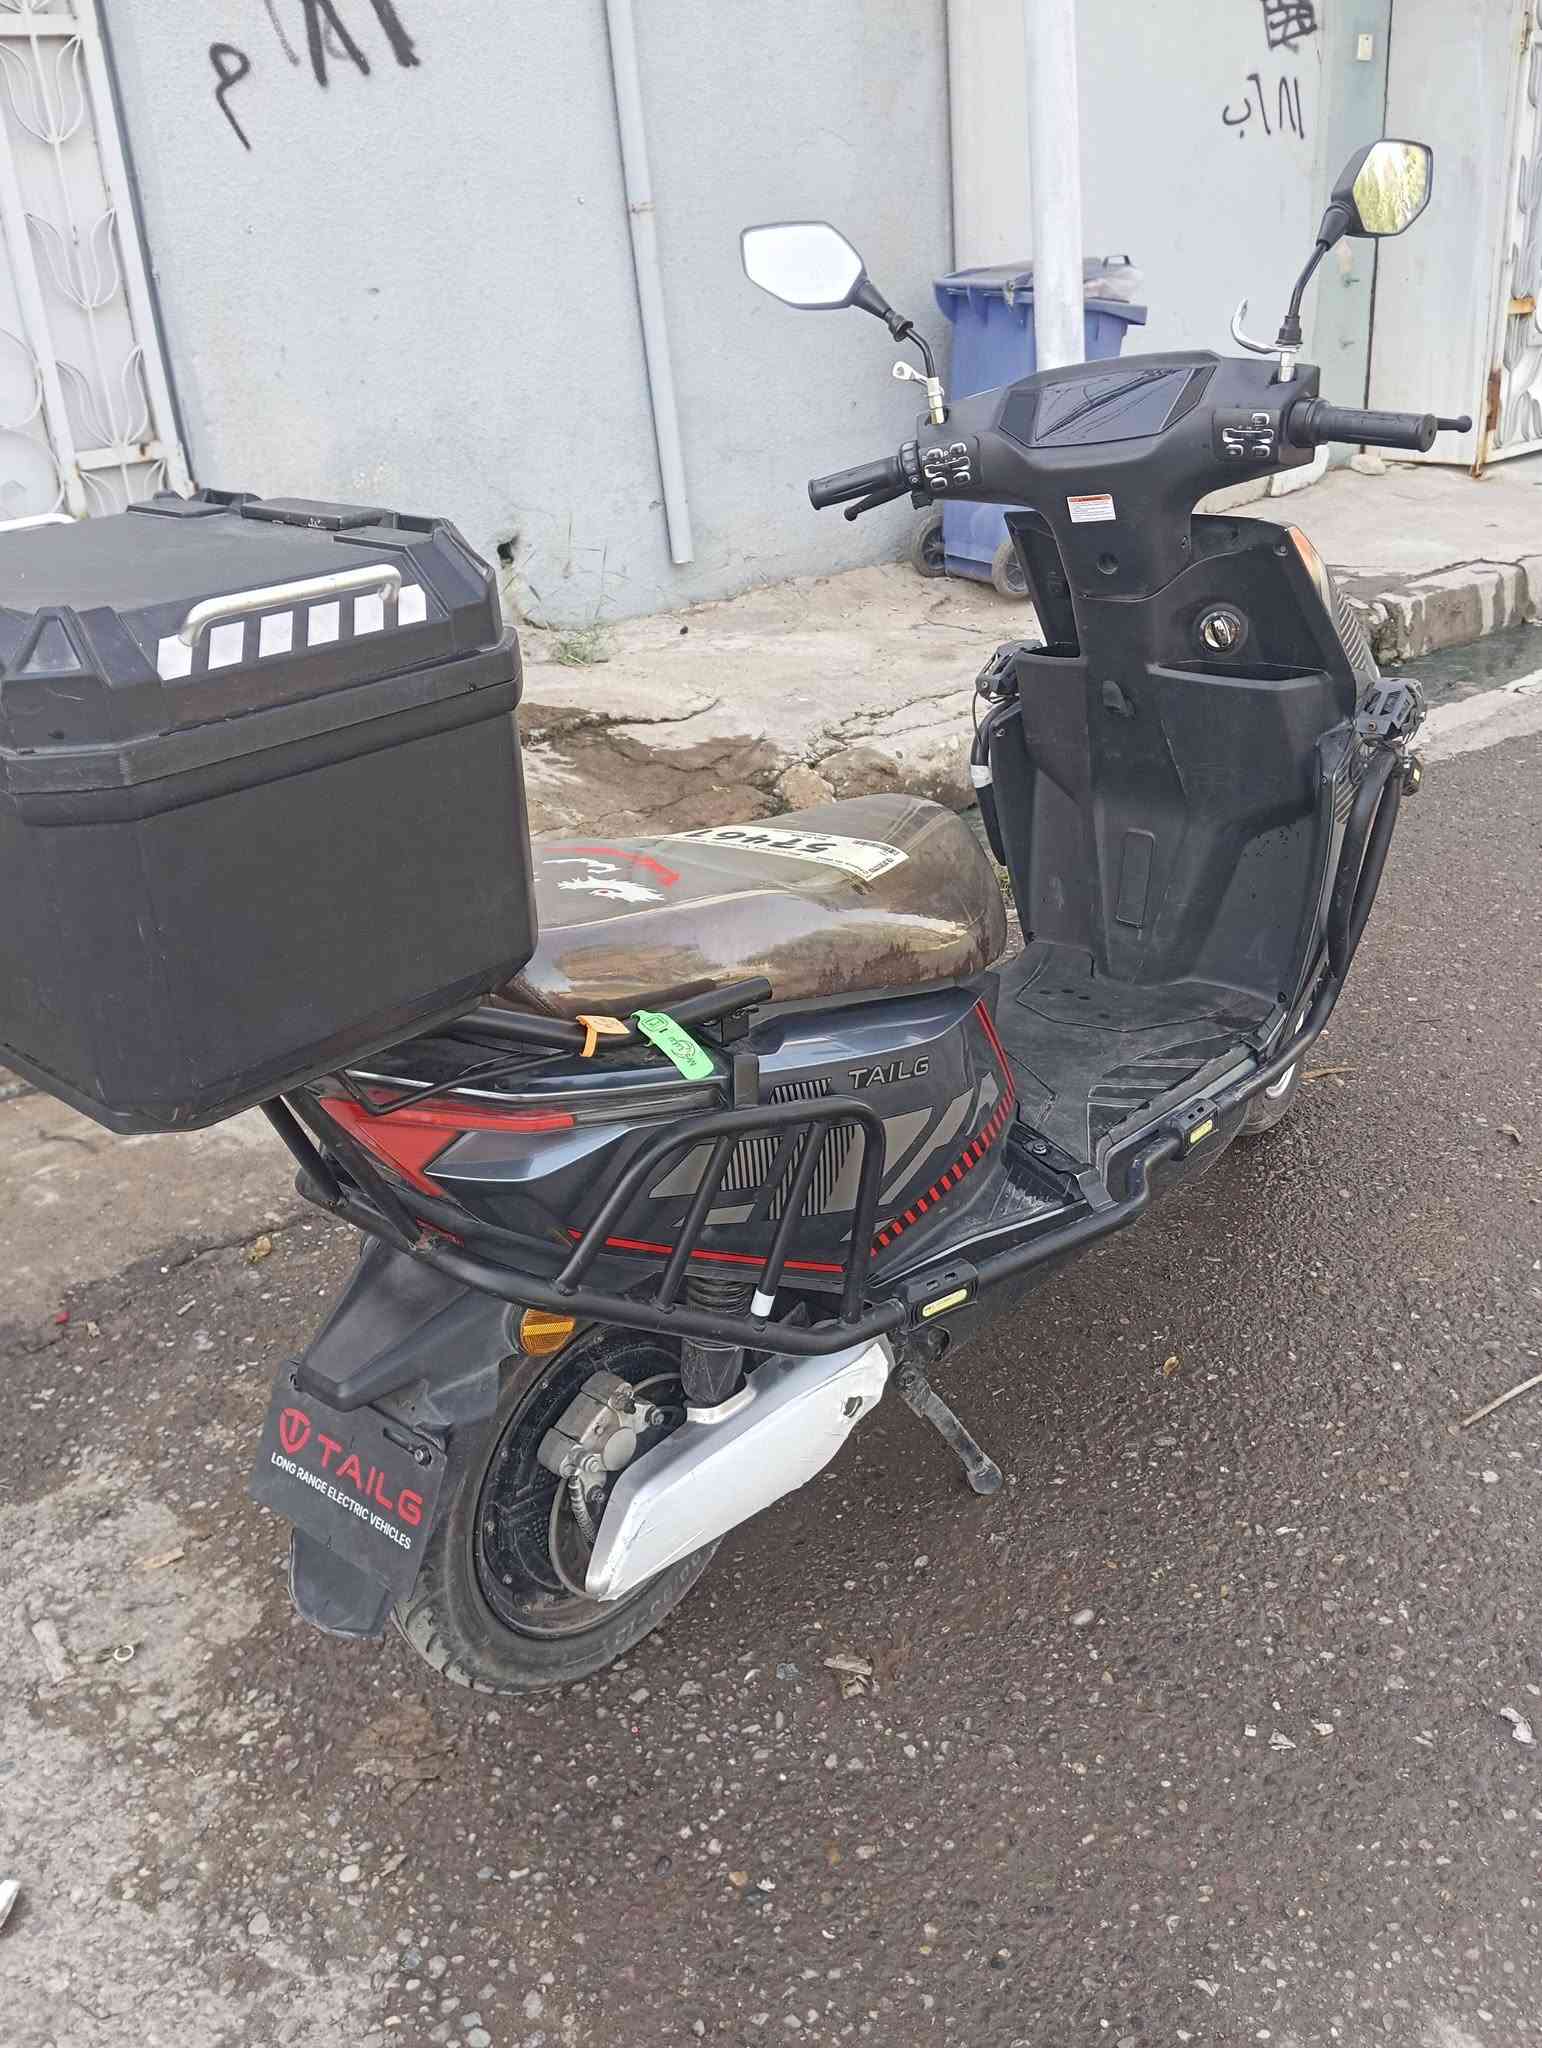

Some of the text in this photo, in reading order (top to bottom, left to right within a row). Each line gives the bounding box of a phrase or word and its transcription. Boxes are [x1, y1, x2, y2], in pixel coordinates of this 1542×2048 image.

[848, 1056, 929, 1089] TAILG
[271, 1451, 412, 1550] LONG RANGE ELECTRIC VEHICLES
[317, 1432, 424, 1527] TAILG
